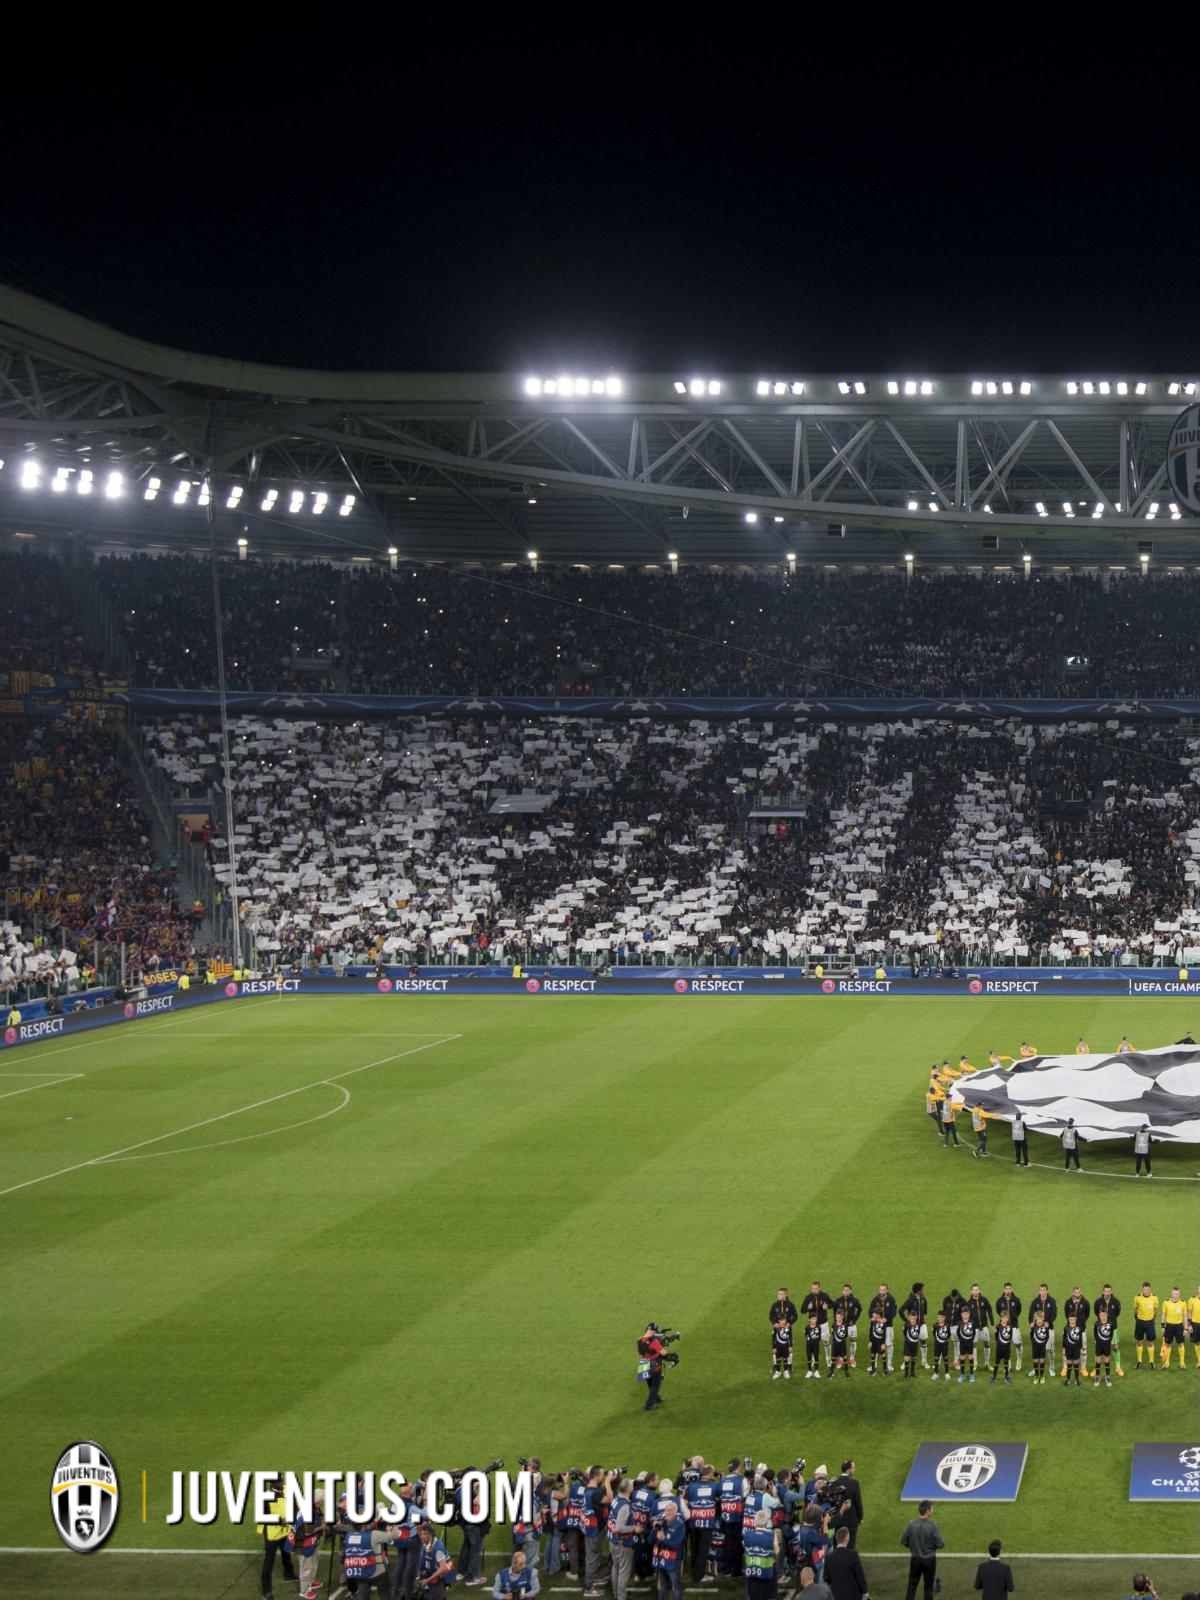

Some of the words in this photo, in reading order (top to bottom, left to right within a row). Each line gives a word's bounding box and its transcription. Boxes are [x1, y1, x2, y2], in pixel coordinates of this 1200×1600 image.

[242, 980, 300, 993] RESPECT
[396, 980, 448, 991] RESPECT
[544, 980, 596, 991] RESPECT
[692, 980, 744, 992] RESPECT
[839, 981, 891, 992] RESPECT
[986, 981, 1039, 992] RESPECT
[1134, 982, 1162, 992] UEFA
[136, 995, 173, 1014] RESPECT
[20, 1018, 64, 1040] RESPECT
